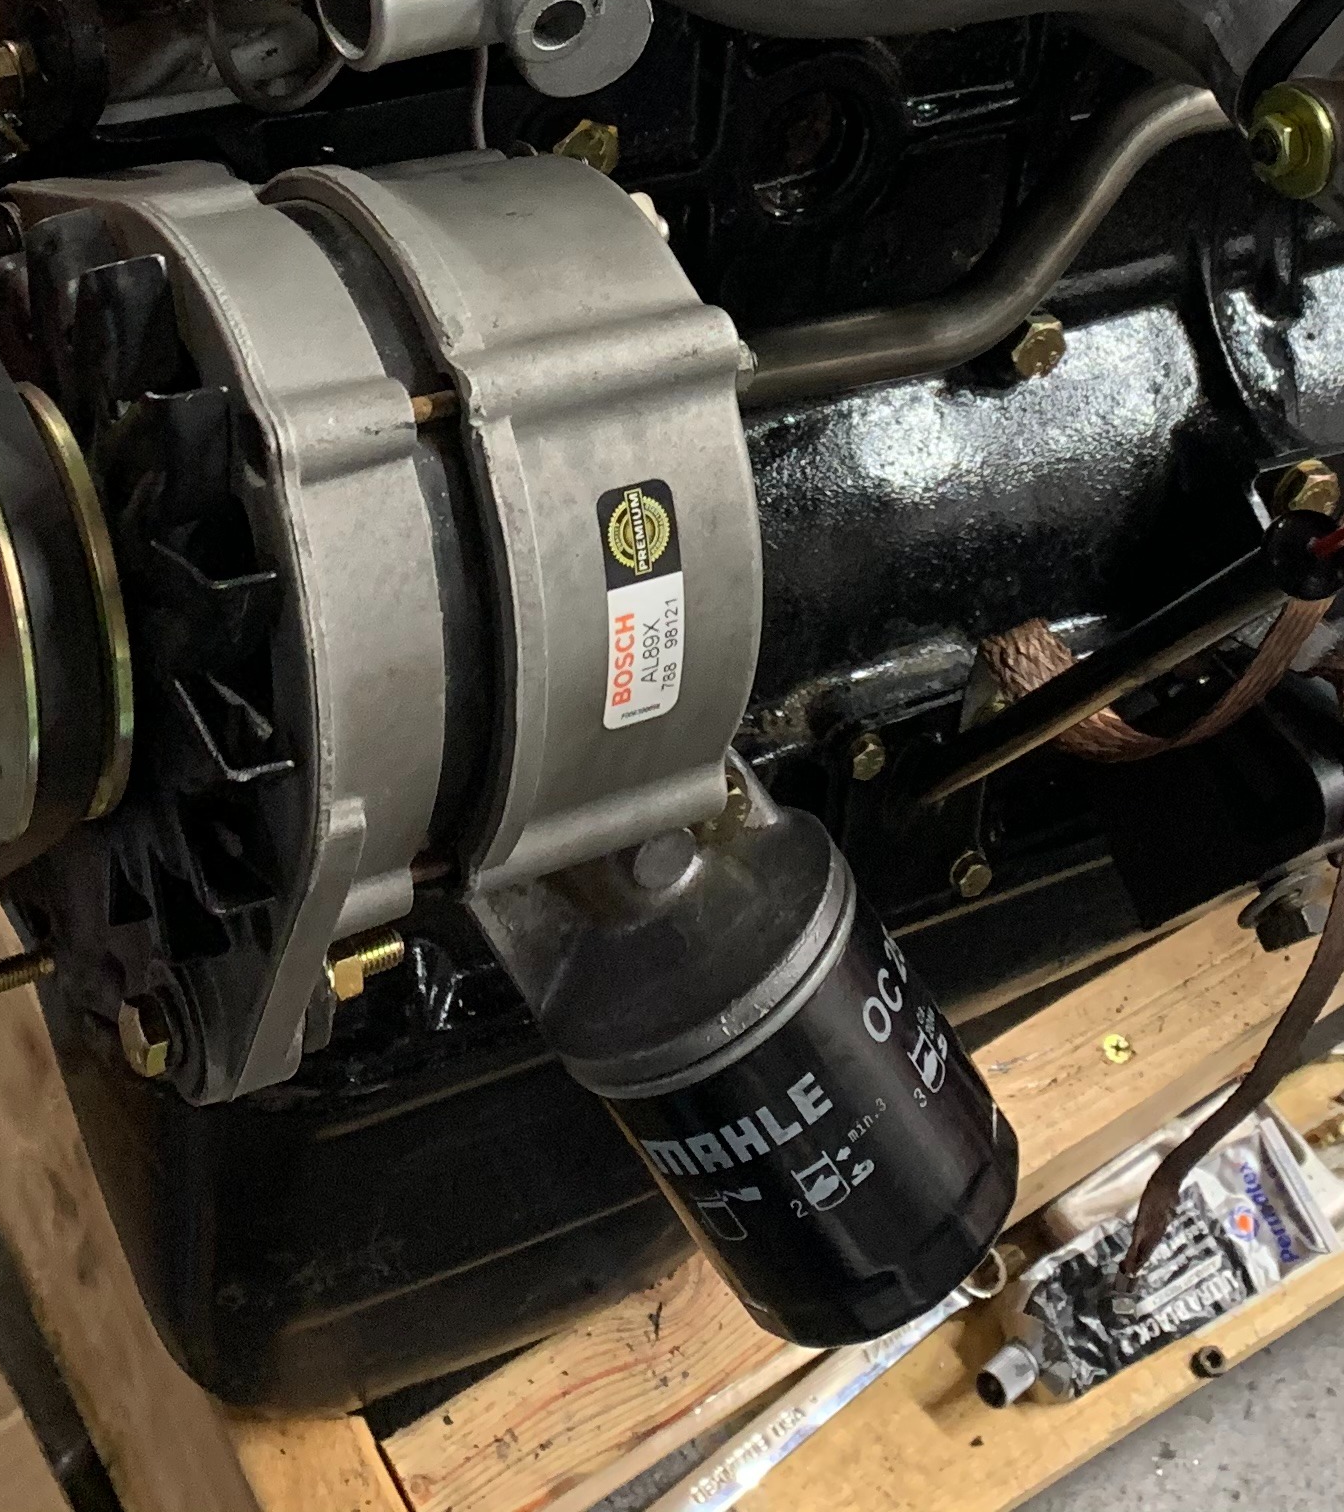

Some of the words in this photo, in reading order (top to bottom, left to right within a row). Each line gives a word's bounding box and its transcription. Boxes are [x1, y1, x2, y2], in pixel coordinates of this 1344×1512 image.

[628, 492, 648, 571] PREMIUM
[641, 618, 660, 682] AL89X
[664, 598, 678, 649] 98121
[612, 613, 635, 706] BOSCH
[661, 662, 677, 692] 788
[862, 968, 903, 1043] OC
[639, 1071, 833, 1176] MAHLE
[913, 1087, 927, 1108] 3
[790, 1199, 808, 1219] 2
